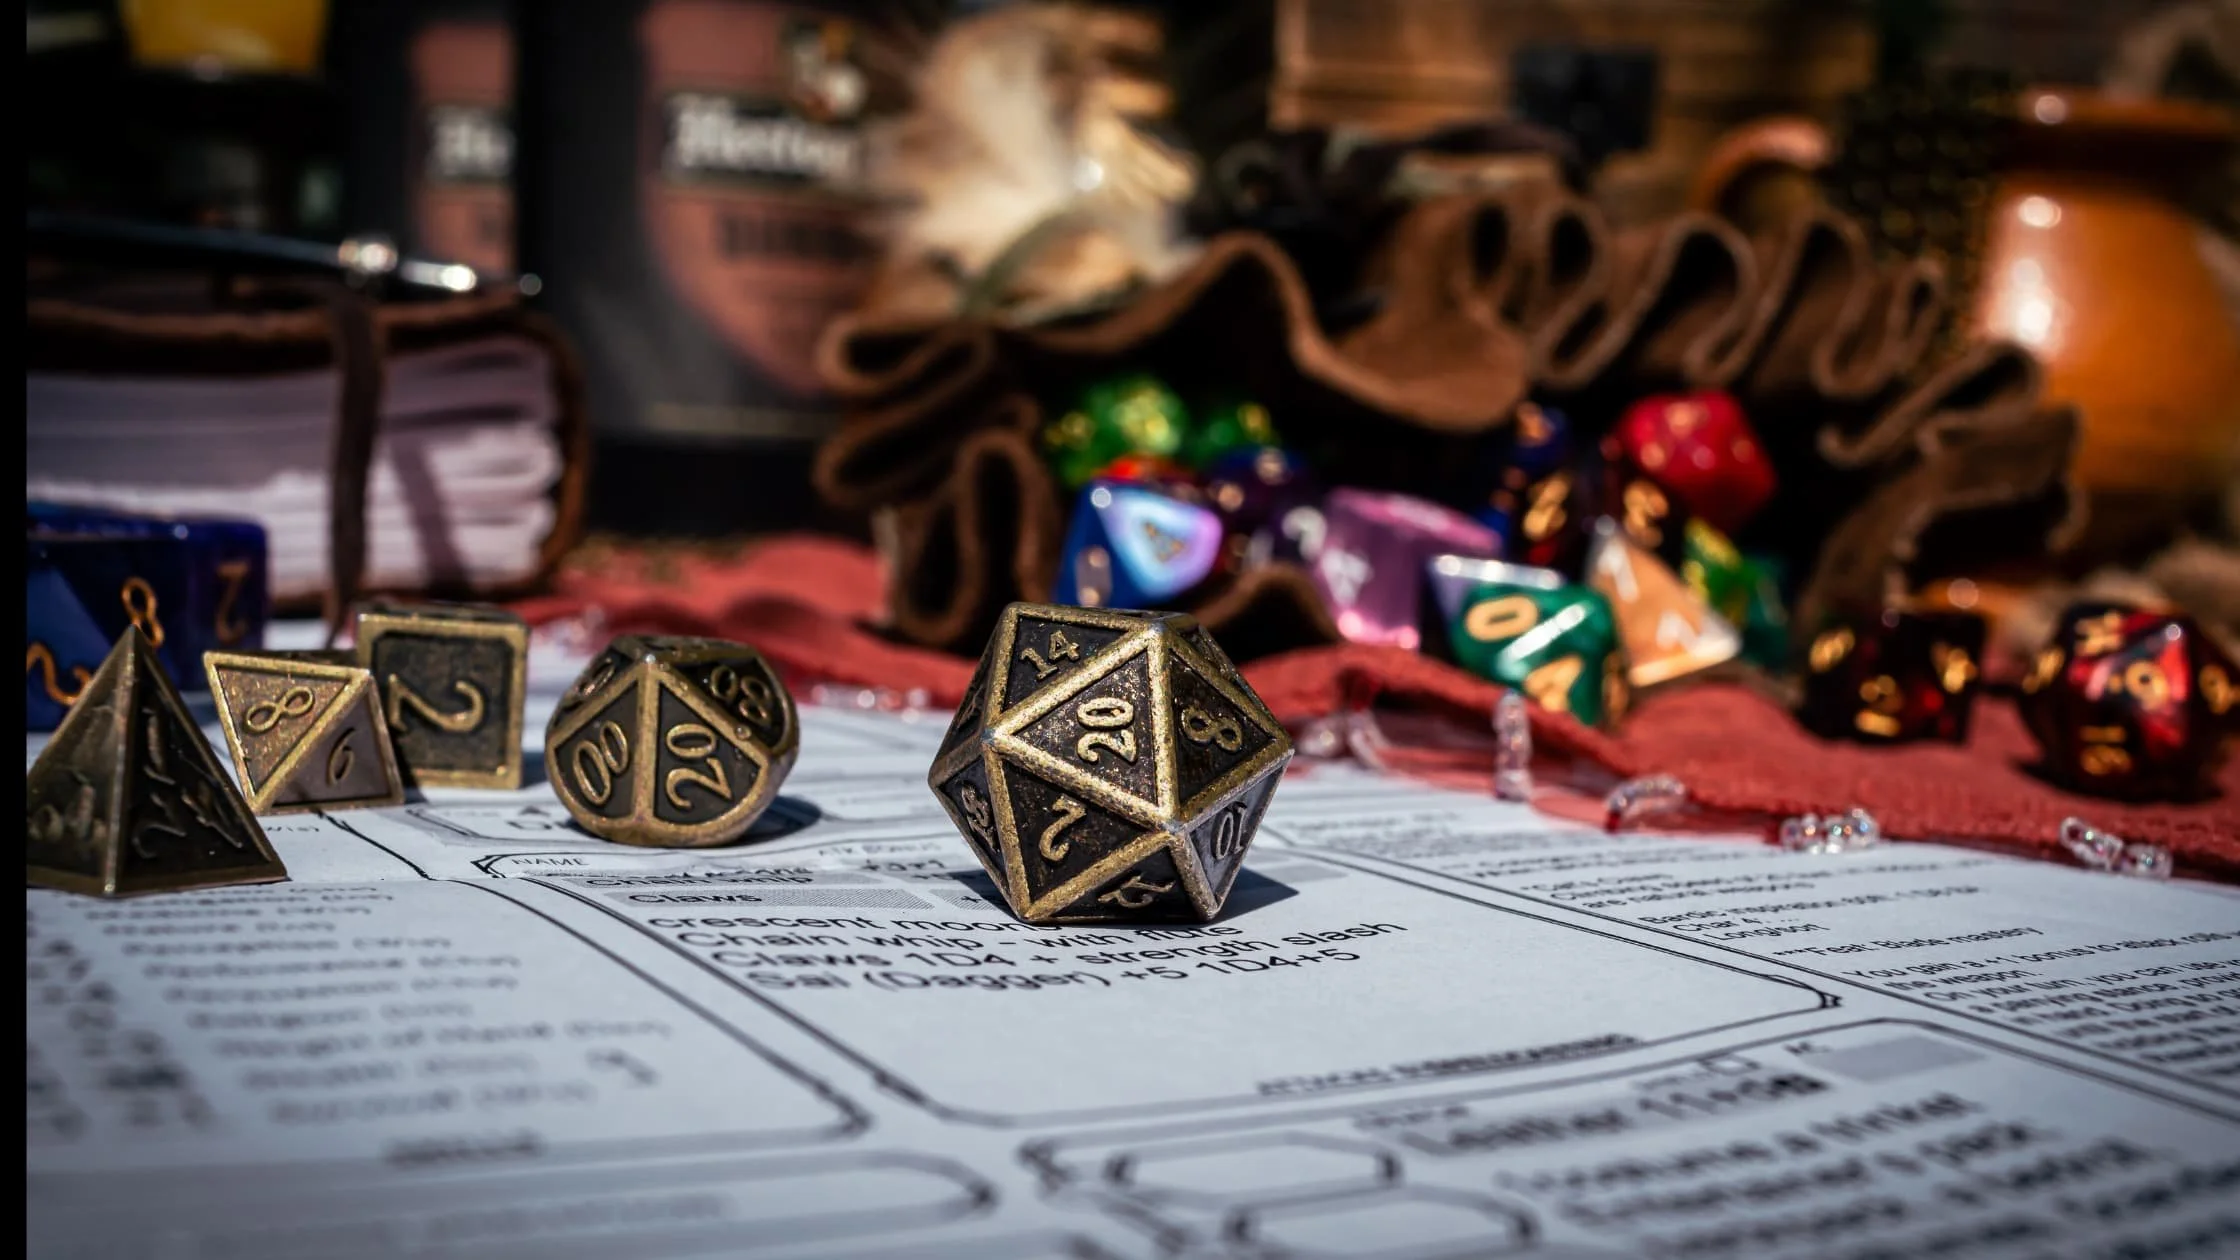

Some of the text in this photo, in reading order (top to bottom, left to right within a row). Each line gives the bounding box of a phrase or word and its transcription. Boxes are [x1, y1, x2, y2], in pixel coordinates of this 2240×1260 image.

[1019, 629, 1081, 680] 14
[246, 686, 316, 735] 8
[387, 672, 486, 734] 2
[1076, 696, 1138, 765] 20
[1181, 704, 1243, 753] 8
[326, 726, 356, 787] 6
[573, 720, 630, 806] 00
[665, 722, 733, 809] 20
[1039, 794, 1088, 862] 2
[1214, 806, 1248, 861] 10
[511, 856, 590, 867] NAME
[628, 893, 762, 903] Claws
[1637, 910, 1728, 924] Bardic
[648, 916, 887, 930] crescent
[676, 931, 850, 947] Chain
[855, 933, 985, 951] whip
[1022, 933, 1134, 948] with
[1133, 925, 1244, 941] flute
[711, 922, 1409, 967] Claws 1D4 + strength slash
[1870, 937, 1950, 950] Blade
[1948, 926, 2045, 945] mastery
[745, 947, 1361, 991] Sai (Dagger) +5 1D4+5
[1841, 968, 1909, 980] You
[1905, 961, 1964, 977] gain
[2011, 947, 2095, 963] bonus
[1883, 968, 2044, 992] the weapon.
[1969, 982, 2032, 999] your
[2086, 971, 2138, 985] you
[2133, 965, 2184, 978] can
